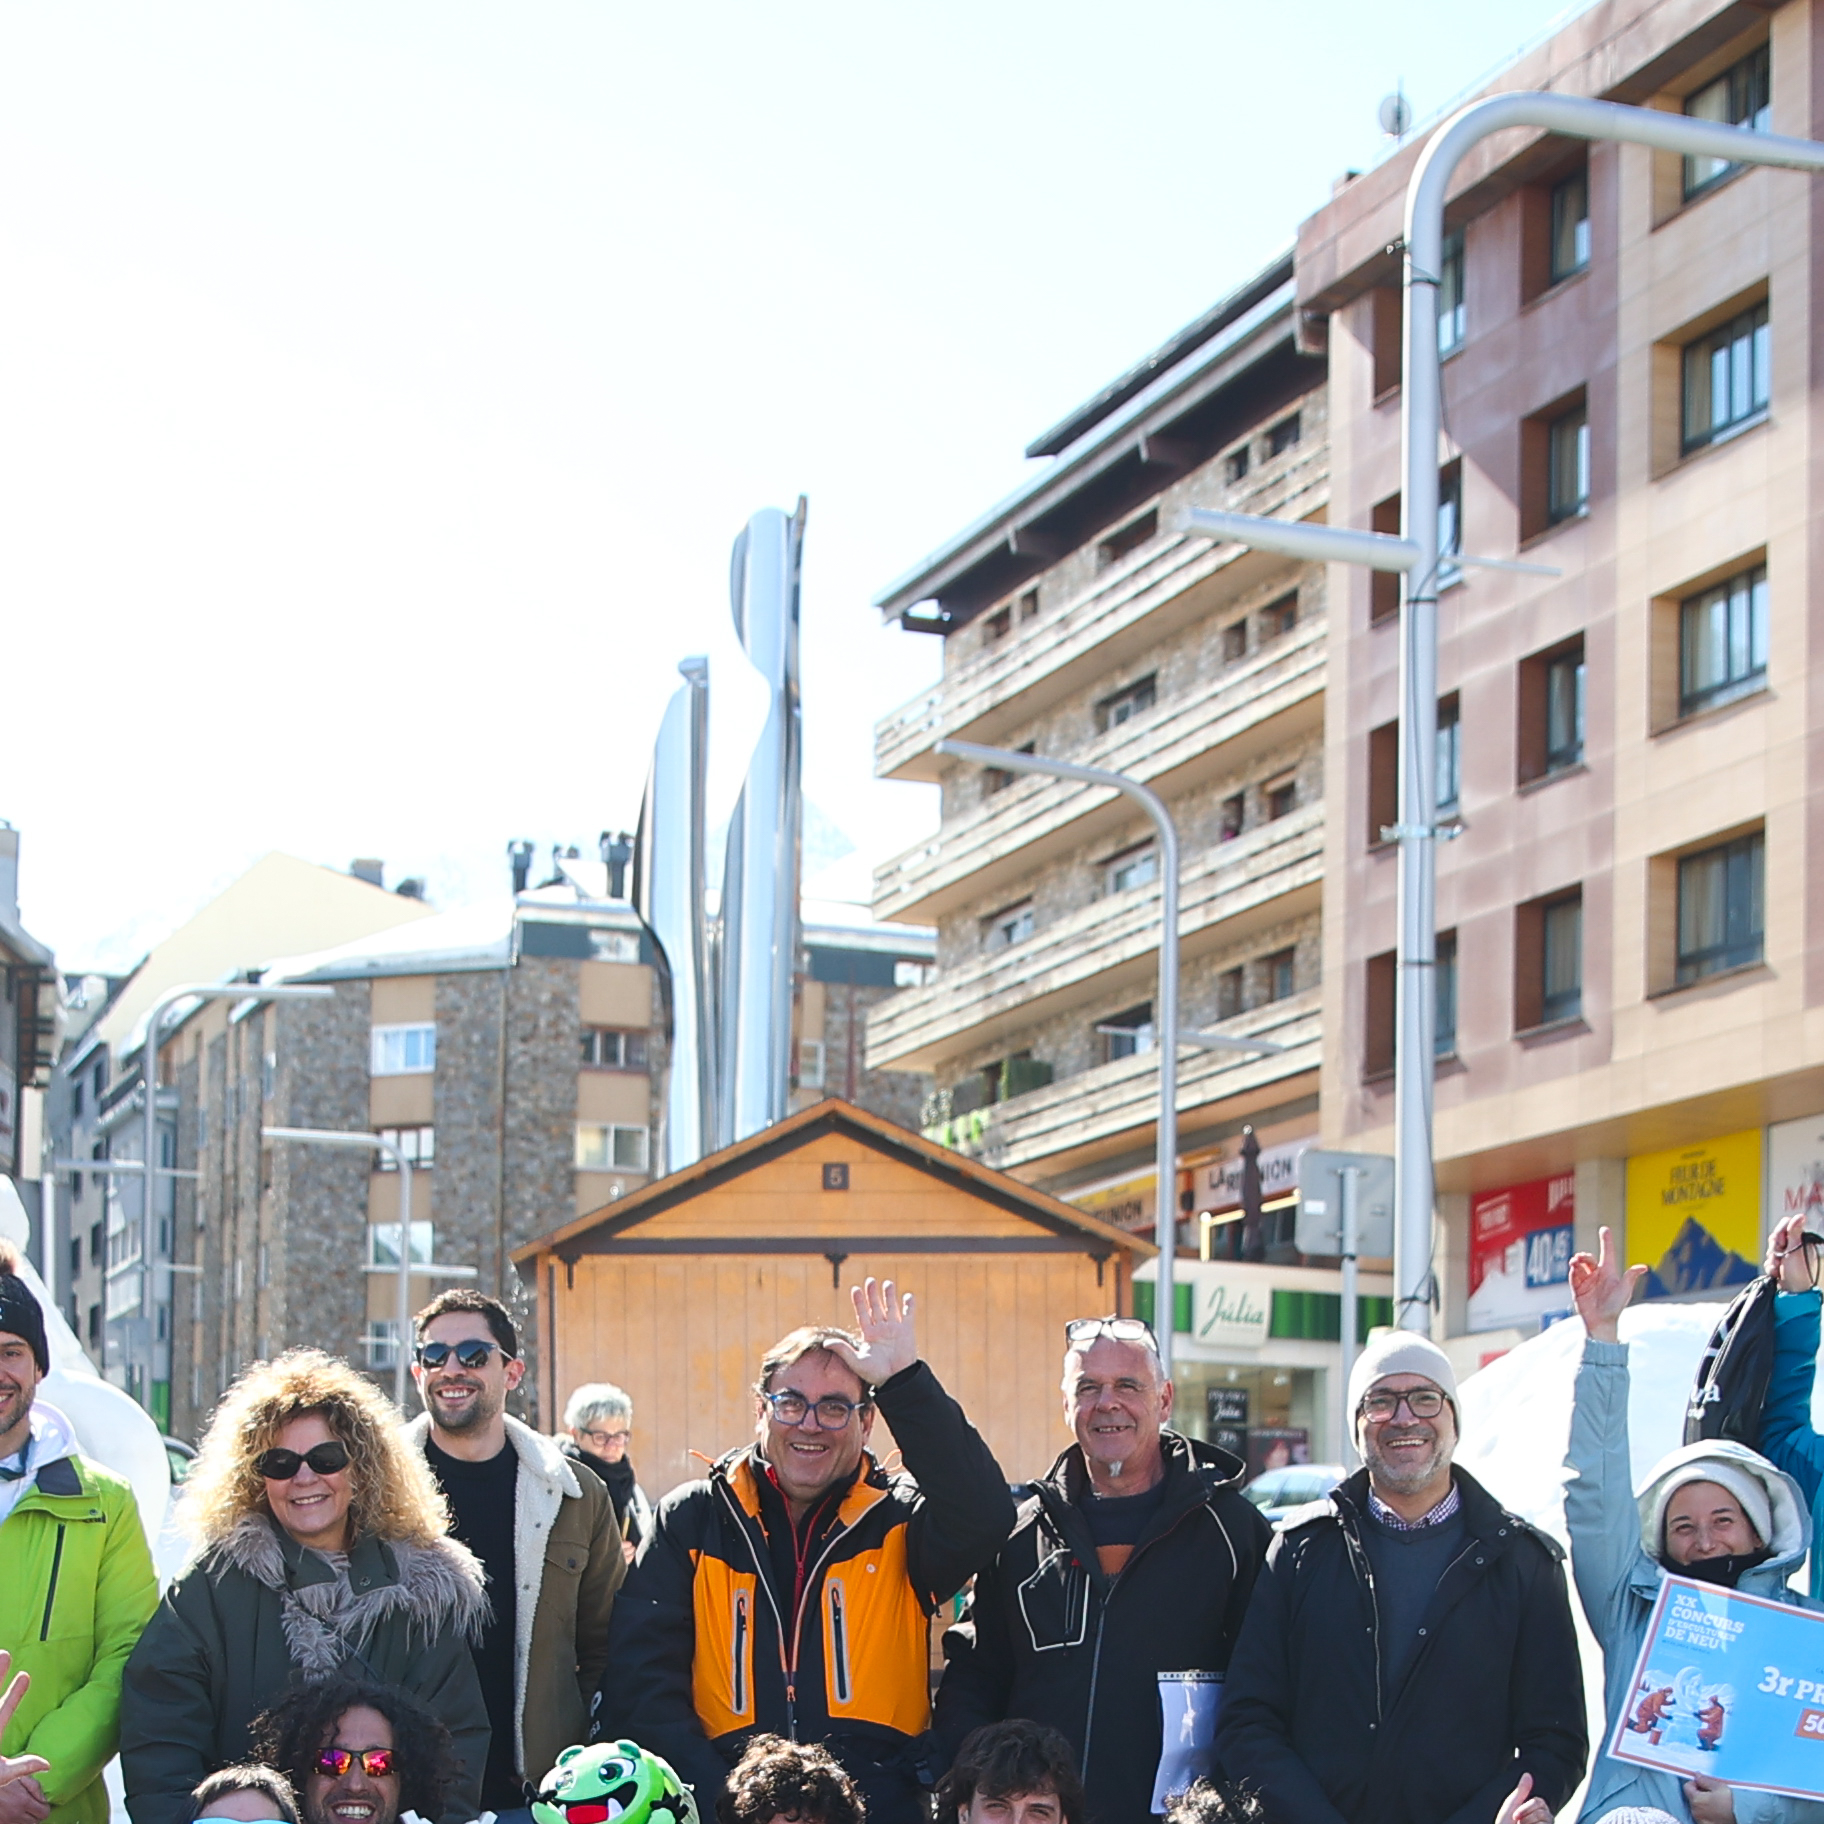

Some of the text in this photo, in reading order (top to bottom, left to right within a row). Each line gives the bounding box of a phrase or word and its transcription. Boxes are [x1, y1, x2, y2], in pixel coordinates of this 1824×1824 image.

[829, 1167, 842, 1187] 5
[1200, 1284, 1264, 1337] Júlia
[1674, 1593, 1699, 1609] XX
[1670, 1606, 1745, 1634] CONCURS
[1663, 1626, 1686, 1642] DE
[1687, 1632, 1721, 1649] NEU
[1757, 1666, 1795, 1698] 3r
